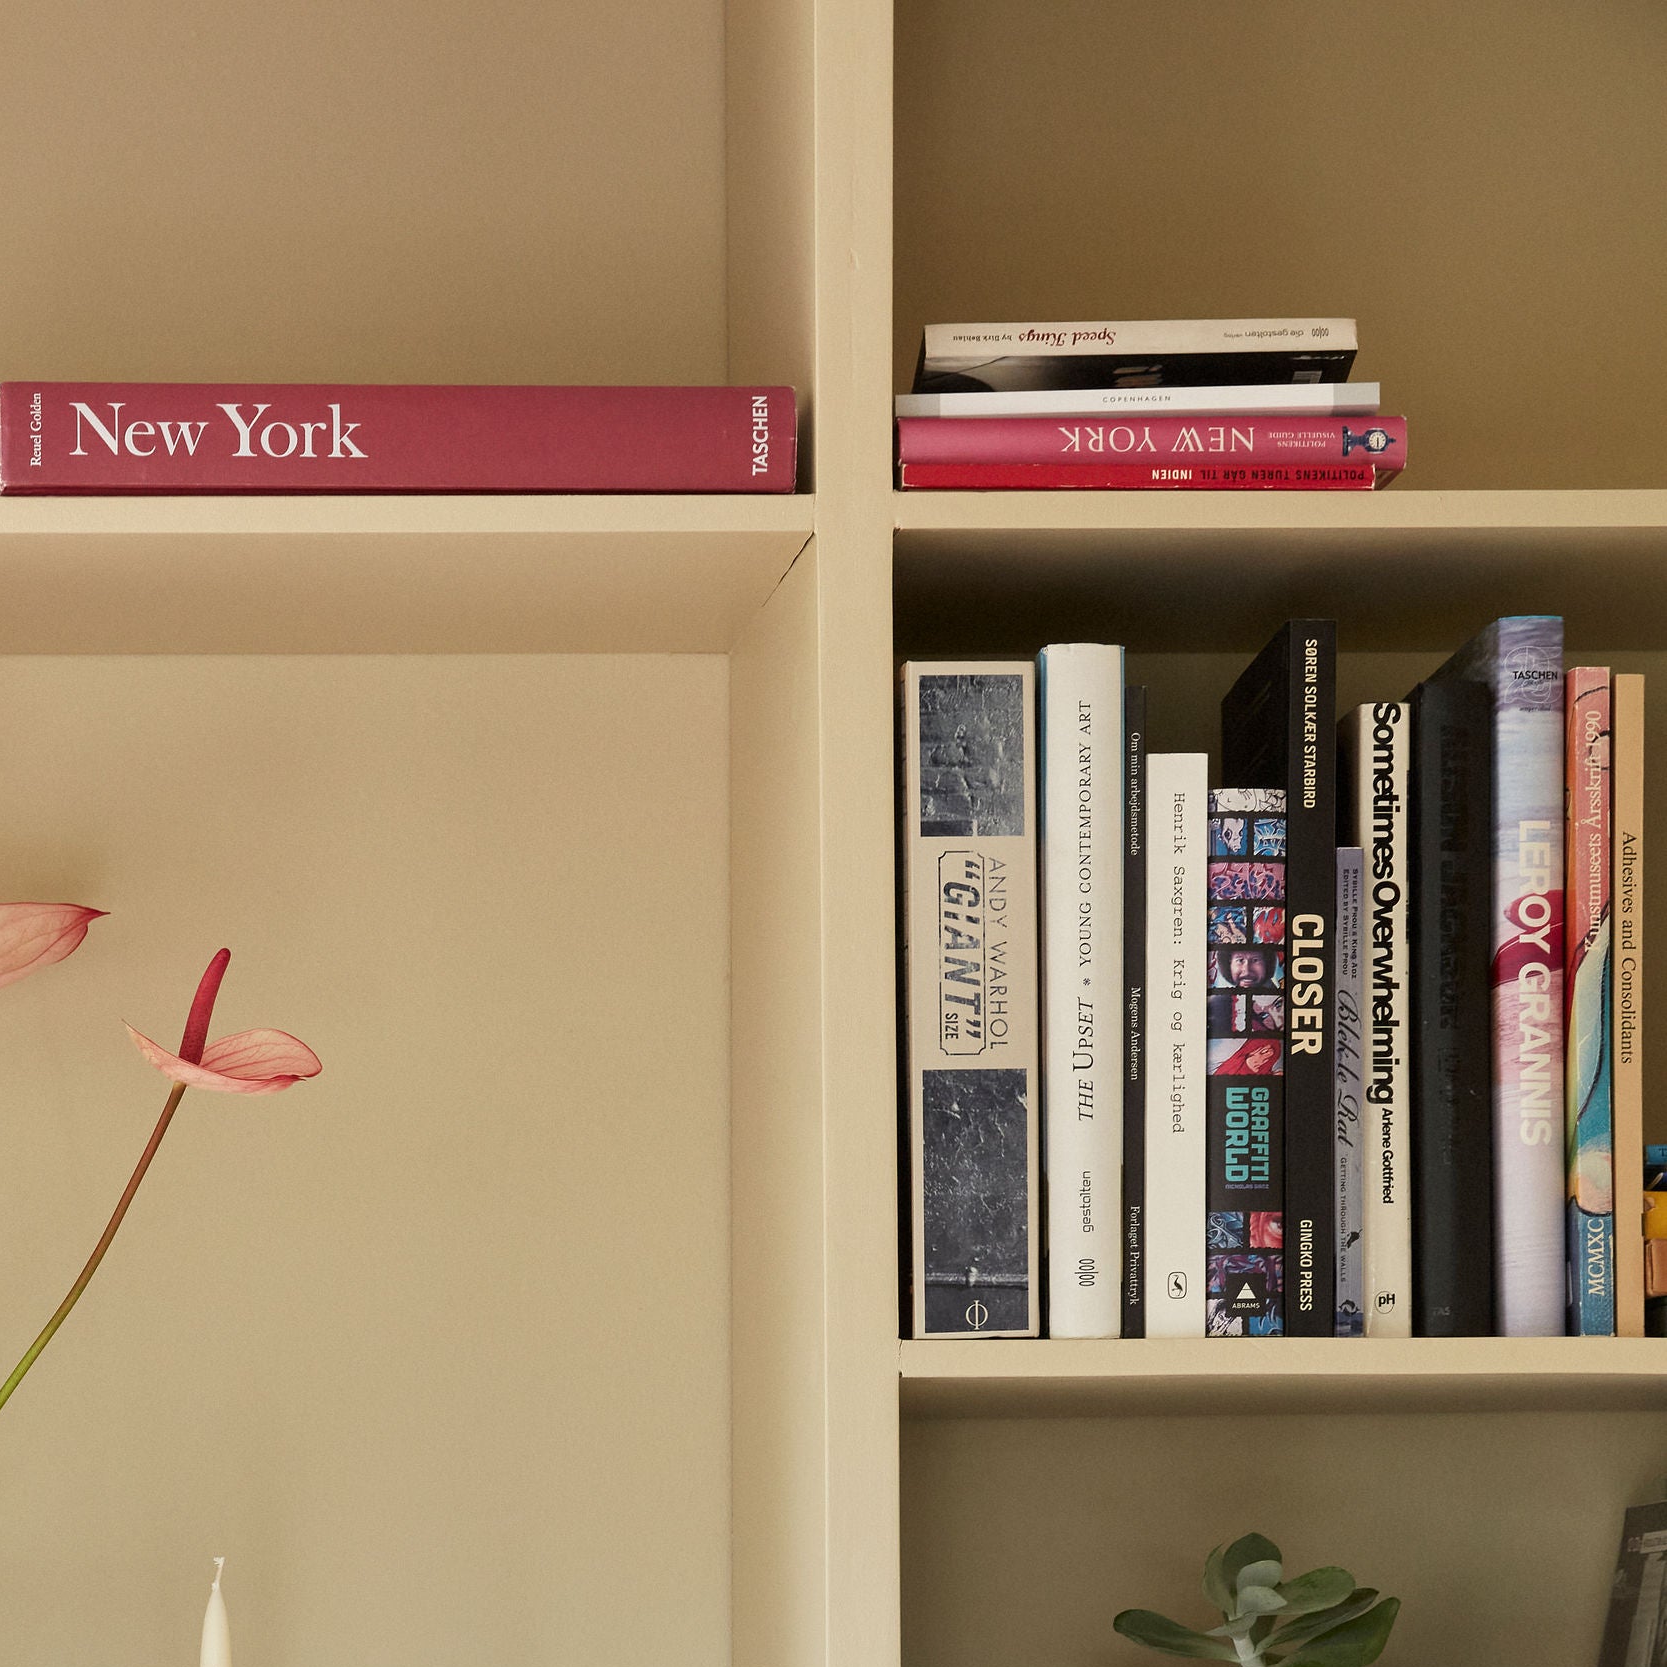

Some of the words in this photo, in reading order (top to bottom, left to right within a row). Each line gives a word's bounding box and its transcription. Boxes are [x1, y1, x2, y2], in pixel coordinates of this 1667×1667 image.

[30, 393, 42, 431] Golden
[1102, 394, 1172, 404] COPENHAGEN
[30, 433, 42, 467] Reuel
[68, 401, 209, 457] New
[216, 402, 369, 459] York
[751, 395, 768, 476] TASCHEN
[1059, 426, 1165, 453] YORK
[1171, 426, 1255, 453] NEW
[1305, 638, 1318, 683] SØREN
[1512, 669, 1558, 681] TASCHEN
[1078, 700, 1092, 735] ART
[1304, 685, 1317, 743] SOLKÆR
[1303, 744, 1317, 810] STARBIRD
[1078, 743, 1092, 894] CONTEMPORARY
[1173, 792, 1186, 856] Henrik
[988, 857, 1008, 929] ANDY
[1518, 820, 1551, 953] LEROY
[1622, 831, 1637, 914] Adhesives
[1078, 902, 1092, 967] YOUNG
[1172, 865, 1186, 946] Saxgren:
[1622, 920, 1637, 950] and
[989, 941, 1009, 1050] WARHOL
[1129, 986, 1140, 1027] Mogens
[1171, 959, 1185, 1000] Krig
[1290, 913, 1325, 1056] CLOSER
[945, 1012, 958, 1040] SIZE
[1172, 1011, 1183, 1032] og
[1621, 957, 1638, 1065] Consolidants
[1129, 1030, 1140, 1081] Andersen
[1517, 962, 1552, 1147] GRANNIS
[1077, 1080, 1095, 1121] THE
[1171, 1043, 1185, 1134] kærlighed
[1225, 1087, 1250, 1182] WORLD
[1250, 1087, 1270, 1182] GRAFFITI
[1382, 1107, 1394, 1149] Arlene
[1079, 1170, 1095, 1233] gestalten
[1382, 1150, 1394, 1205] Gottfried
[1299, 1218, 1313, 1268] GINGKO
[1587, 1218, 1605, 1297] MCMXC
[1299, 1270, 1313, 1312] PRESS
